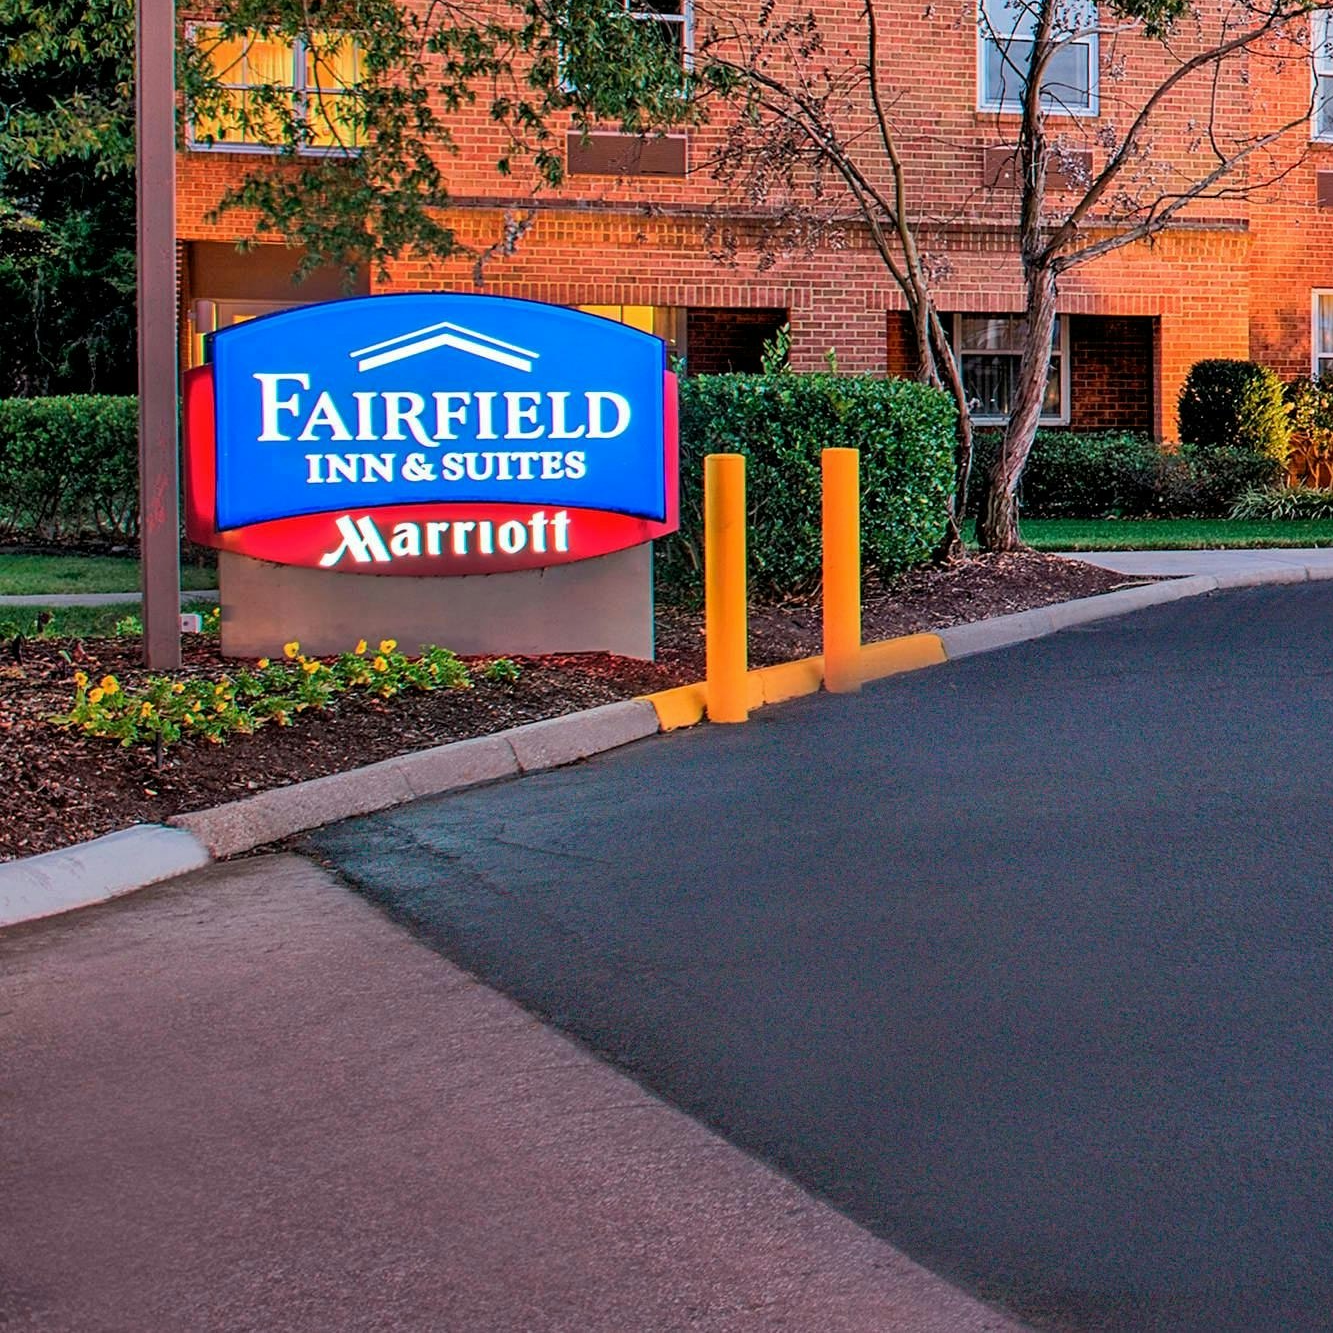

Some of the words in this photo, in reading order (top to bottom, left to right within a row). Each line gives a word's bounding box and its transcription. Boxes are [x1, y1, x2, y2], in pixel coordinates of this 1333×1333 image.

[252, 371, 632, 448] FAIRFIELD
[305, 452, 395, 484] INN
[401, 452, 437, 482] &
[441, 450, 587, 481] SUITES
[319, 509, 571, 567] Marriott
